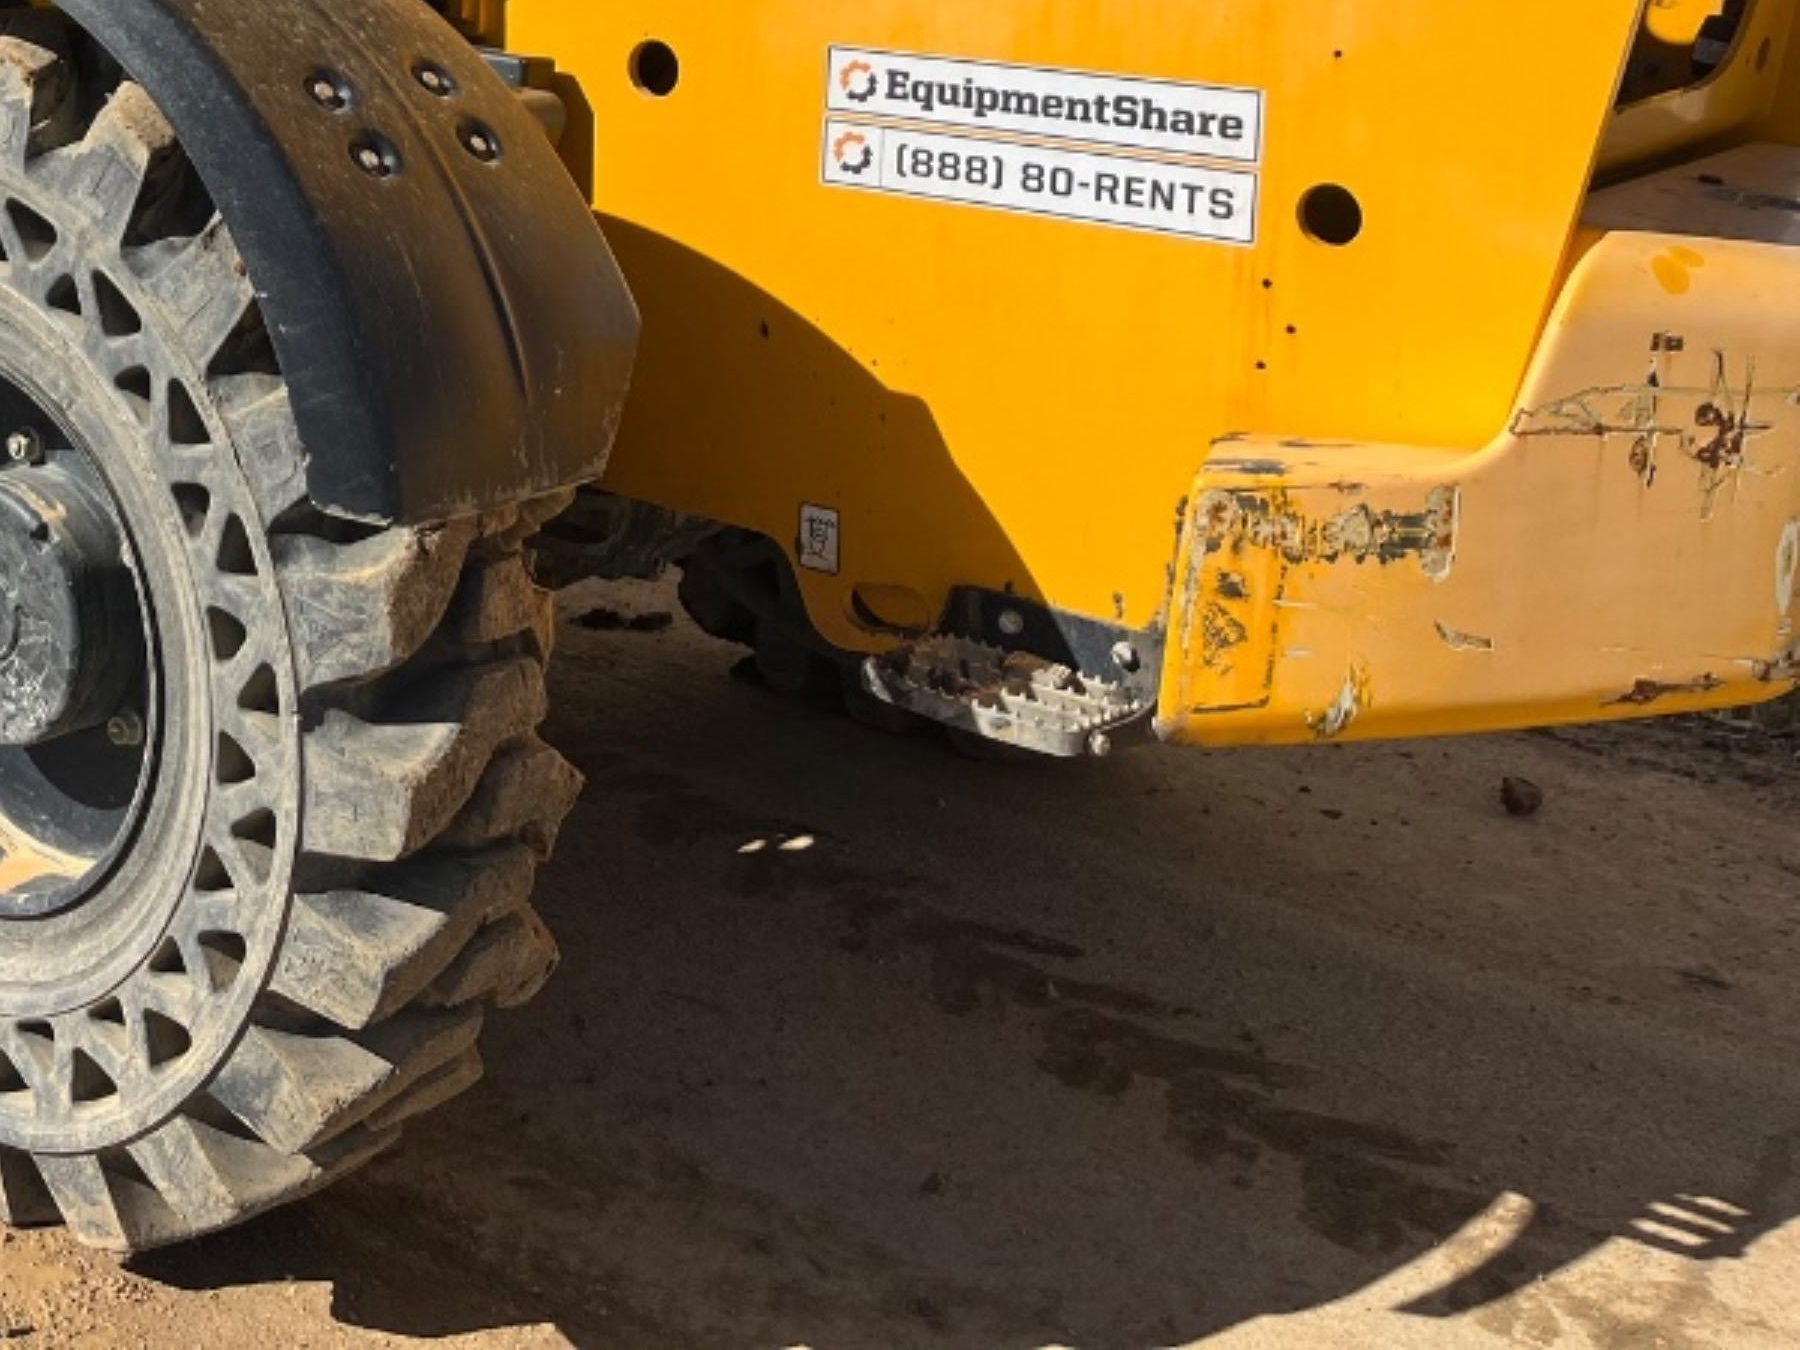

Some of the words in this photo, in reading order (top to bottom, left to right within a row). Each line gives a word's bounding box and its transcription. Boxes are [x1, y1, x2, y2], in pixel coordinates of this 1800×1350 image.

[885, 68, 1244, 141] EquipmentShare
[896, 143, 1004, 190] (888)
[1020, 161, 1236, 221] 80-RENTS
